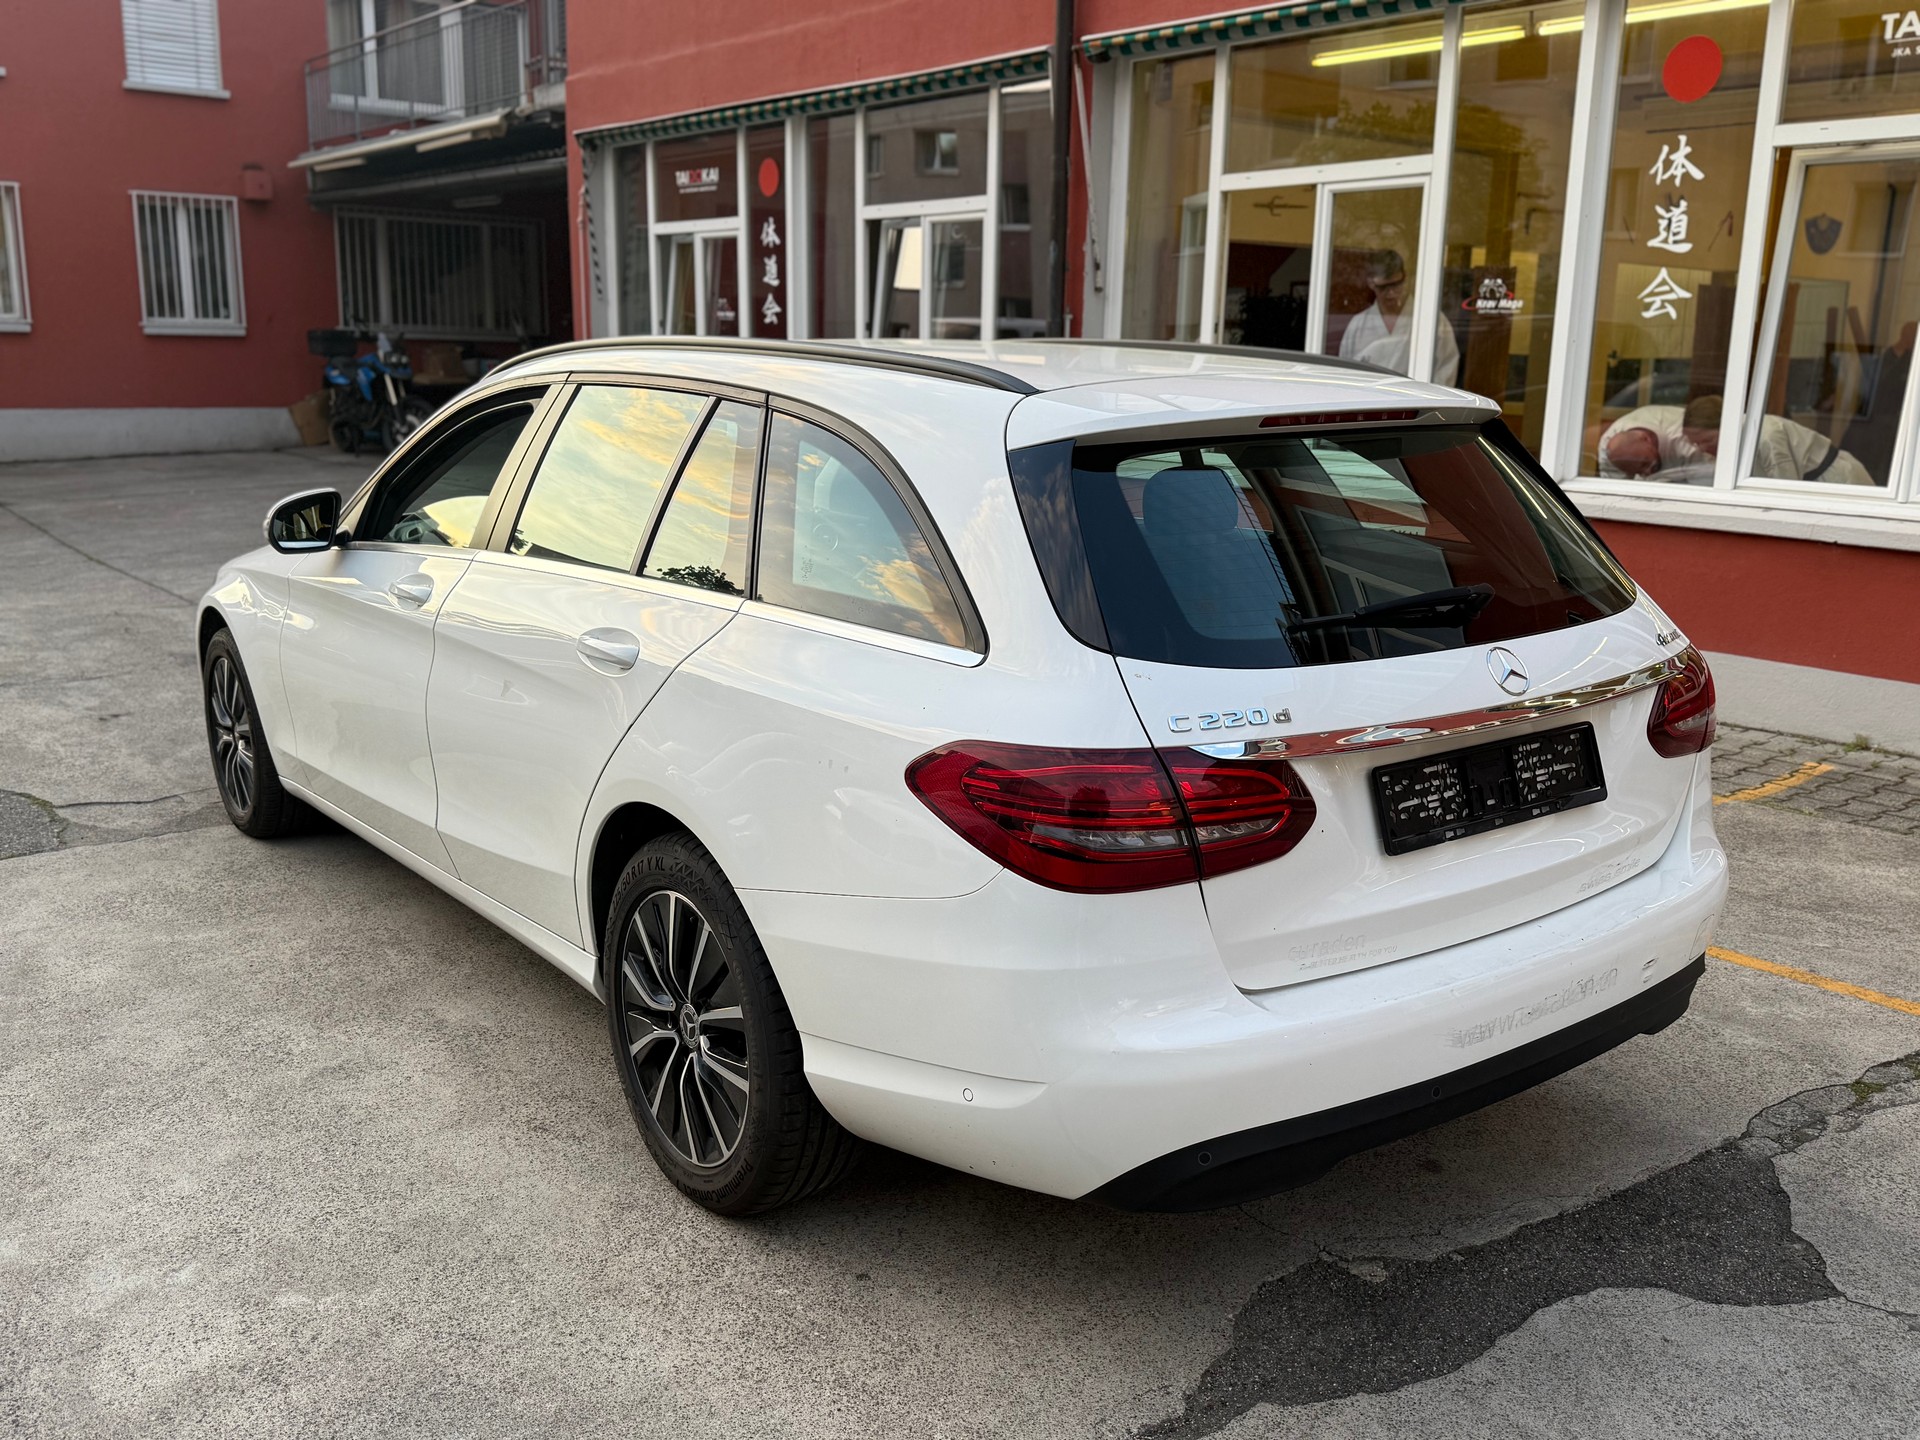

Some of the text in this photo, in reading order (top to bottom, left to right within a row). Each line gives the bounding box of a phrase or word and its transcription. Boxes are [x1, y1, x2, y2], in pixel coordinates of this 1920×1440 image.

[760, 216, 782, 325] 体道会
[1637, 134, 1705, 320] 体道会
[1167, 707, 1292, 733] C 220 d
